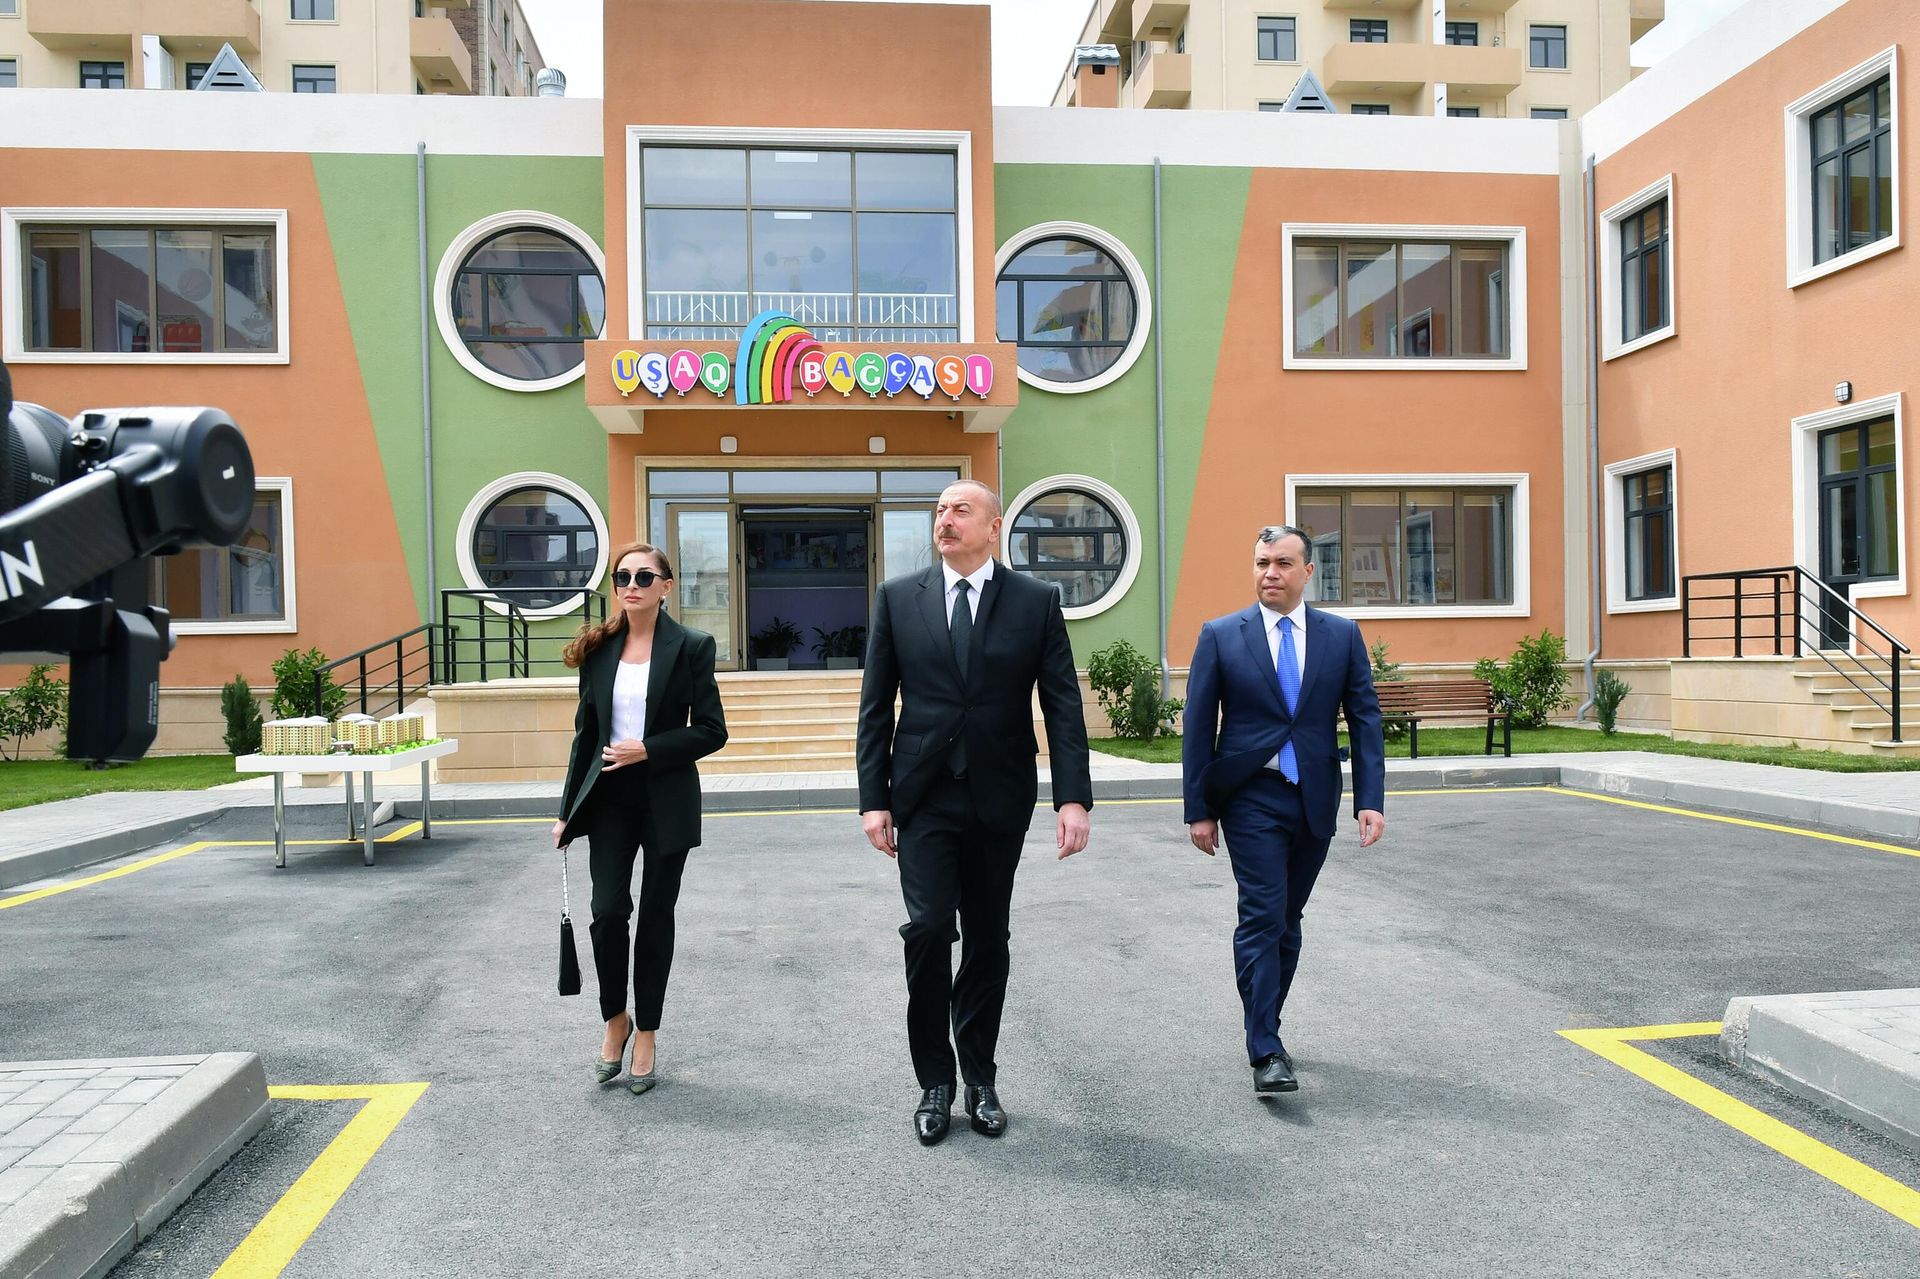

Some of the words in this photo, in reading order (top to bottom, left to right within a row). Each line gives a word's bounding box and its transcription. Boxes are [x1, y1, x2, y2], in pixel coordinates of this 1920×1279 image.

[616, 354, 728, 390] UŞAQ
[804, 354, 985, 389] BAĞÇASI
[31, 472, 55, 486] SONY
[0, 540, 45, 602] N
